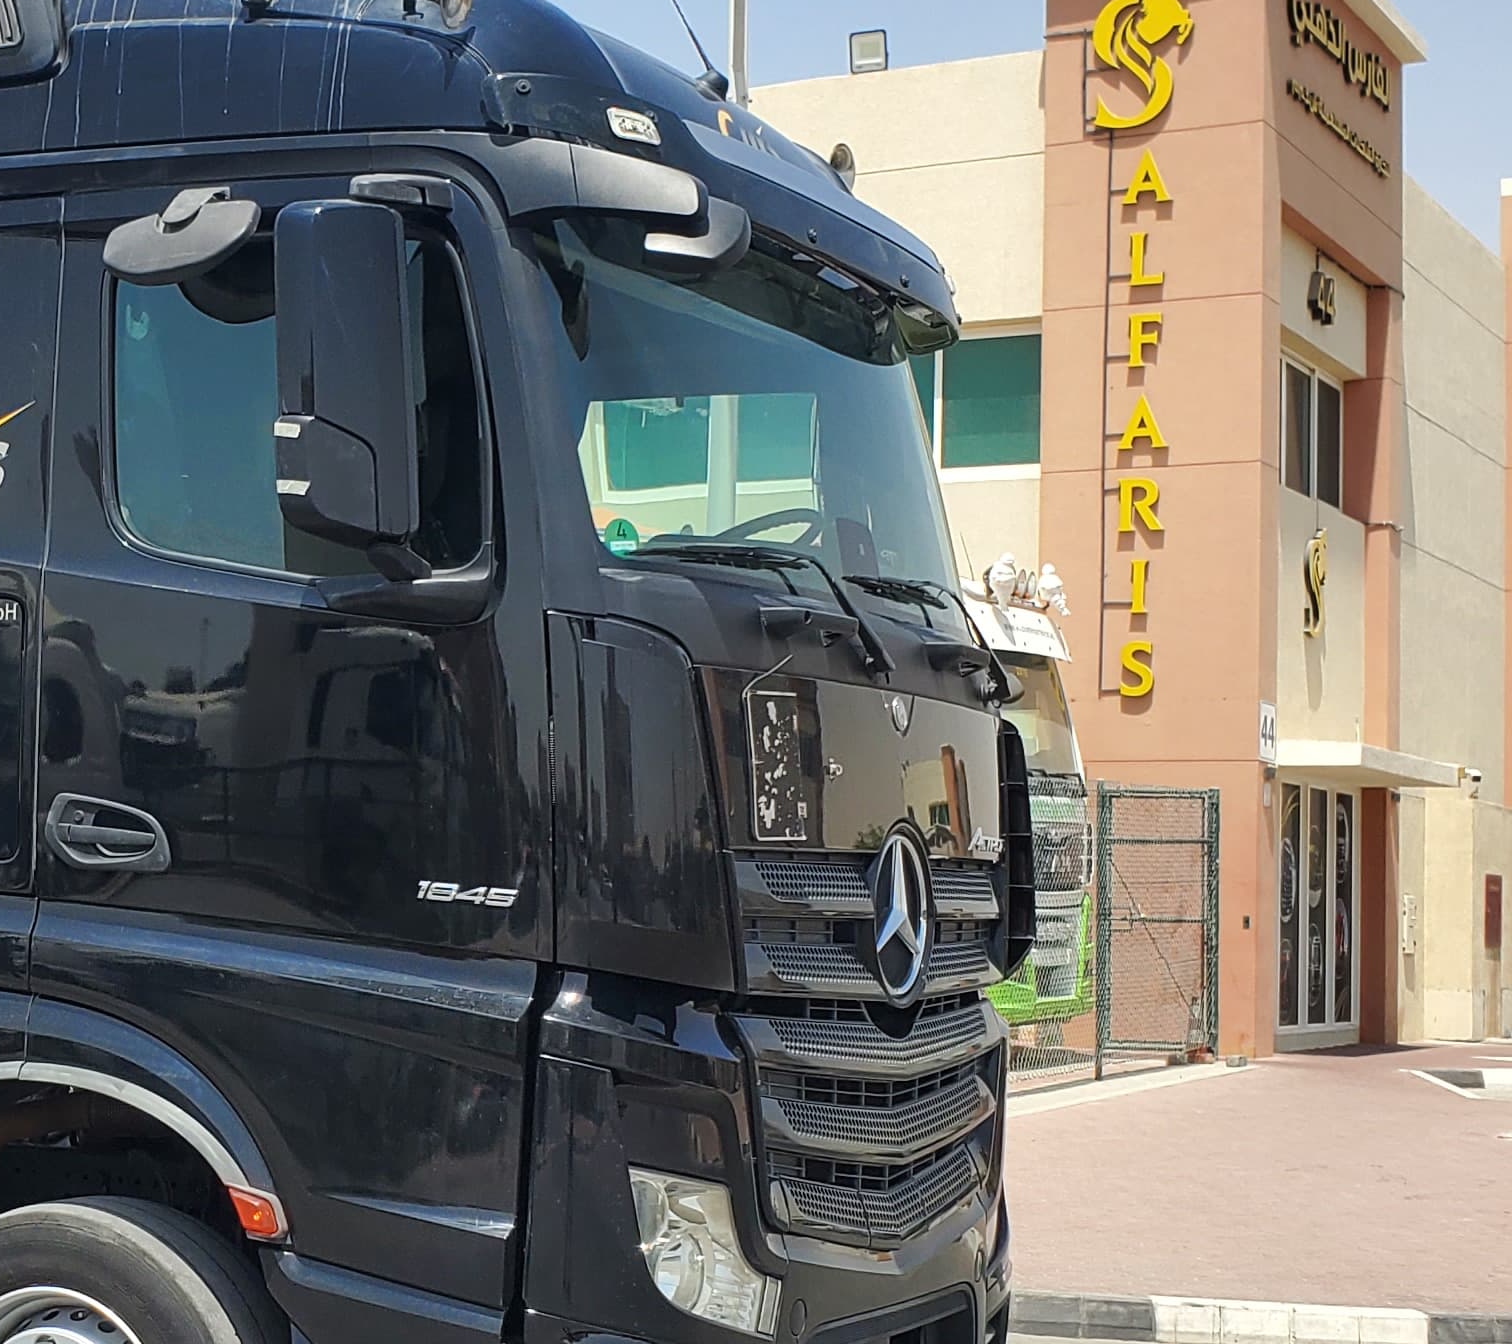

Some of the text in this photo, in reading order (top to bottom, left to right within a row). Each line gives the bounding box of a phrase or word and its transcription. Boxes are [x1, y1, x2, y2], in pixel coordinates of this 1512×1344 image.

[617, 522, 627, 539] 4
[1260, 714, 1275, 750] 44
[416, 879, 520, 909] 1845
